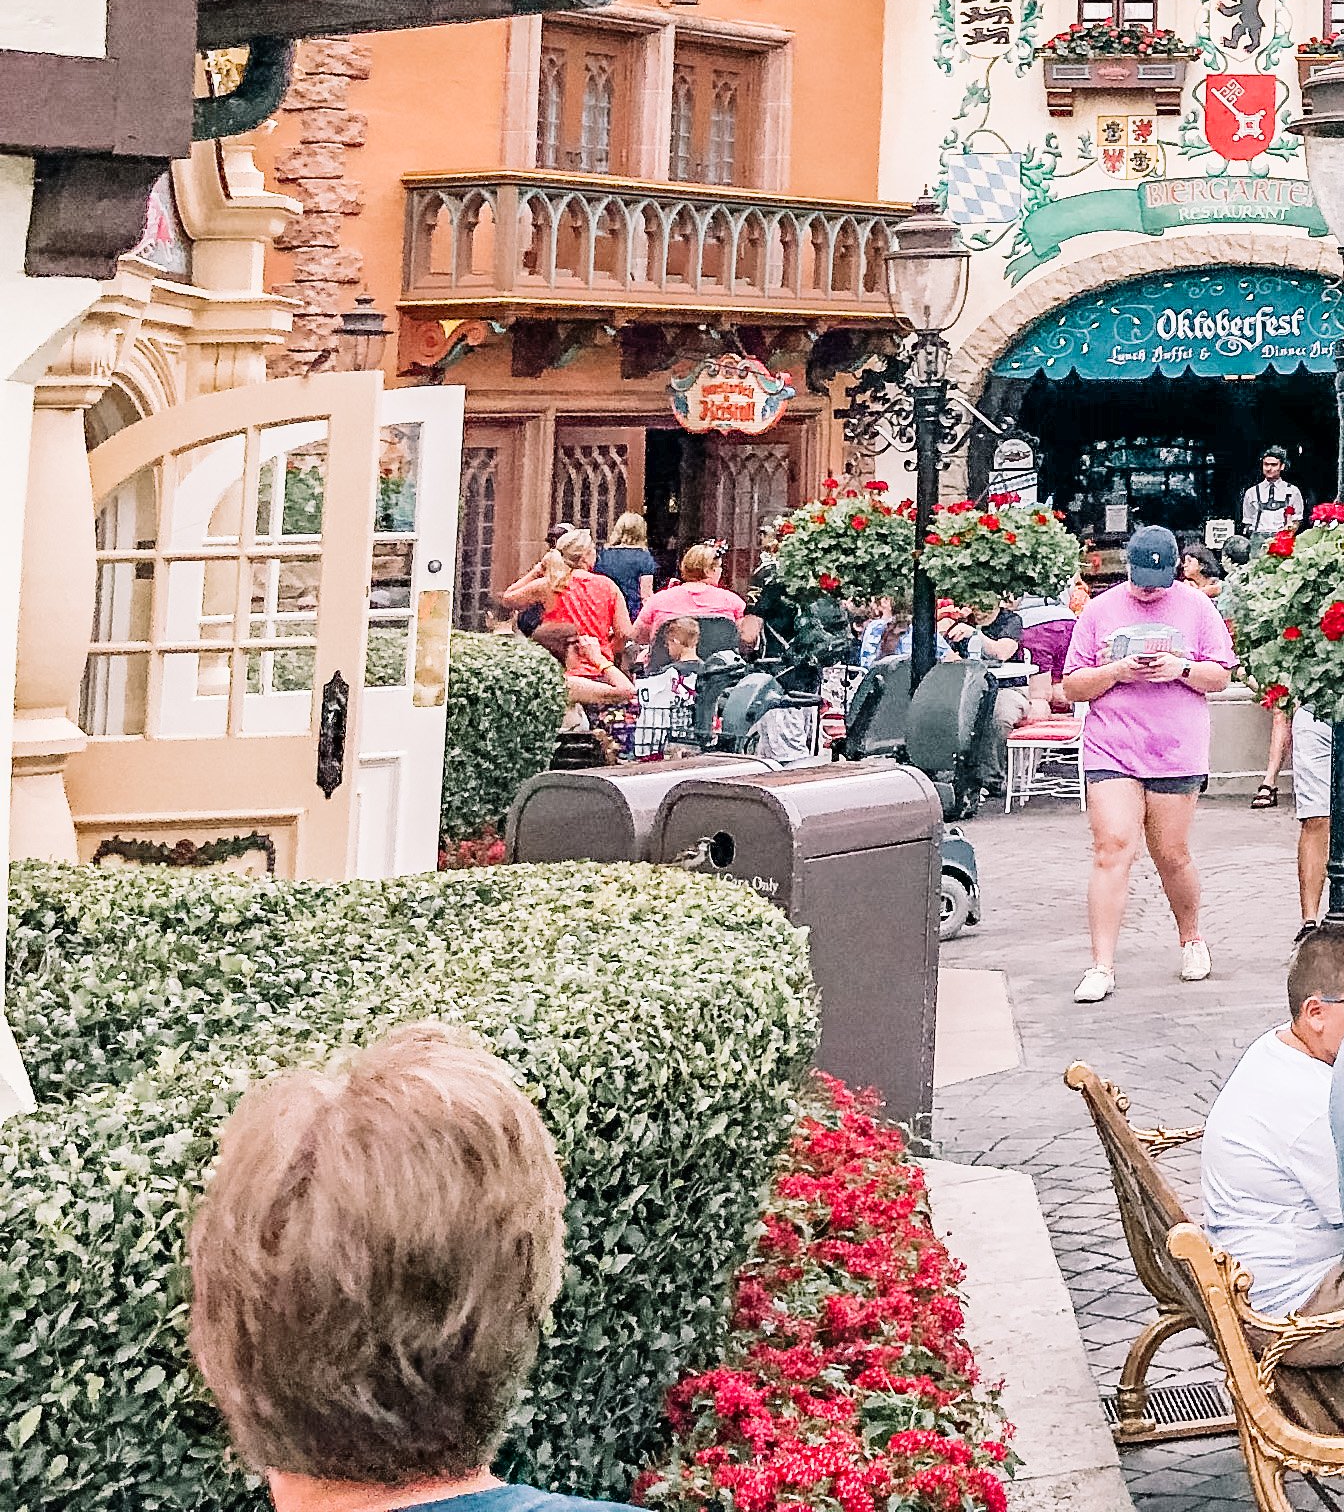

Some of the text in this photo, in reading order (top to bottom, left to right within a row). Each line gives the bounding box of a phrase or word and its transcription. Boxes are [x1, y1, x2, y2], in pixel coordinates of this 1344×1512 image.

[1178, 205, 1291, 221] RESTAURANT
[1156, 306, 1305, 356] Oktoberfest
[1309, 341, 1335, 358] Buf
[752, 875, 779, 896] Only
